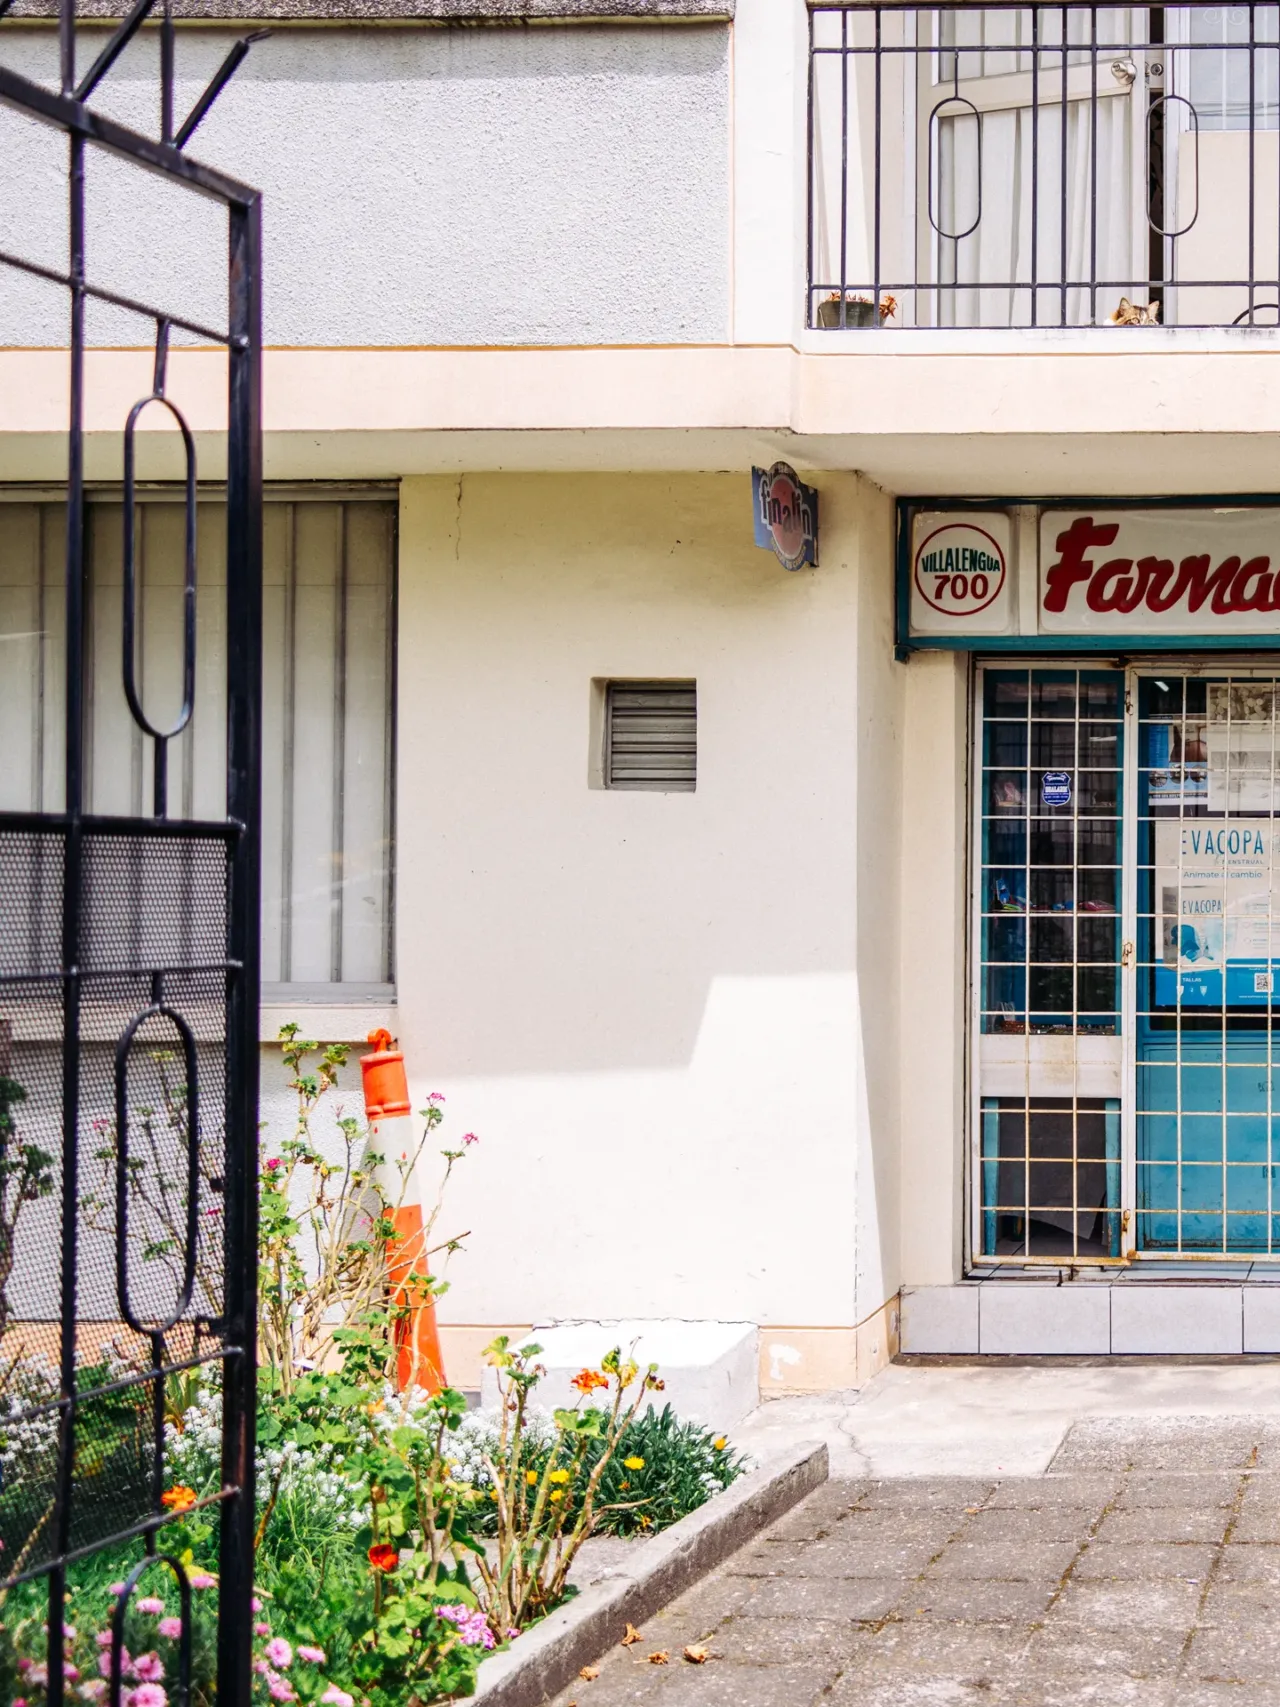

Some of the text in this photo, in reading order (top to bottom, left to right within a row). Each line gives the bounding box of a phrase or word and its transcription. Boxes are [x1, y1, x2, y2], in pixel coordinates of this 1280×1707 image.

[921, 547, 1001, 573] VILLALENGUA
[933, 573, 989, 600] 700
[1230, 871, 1263, 879] cambio
[1182, 899, 1222, 915] EVACOPA
